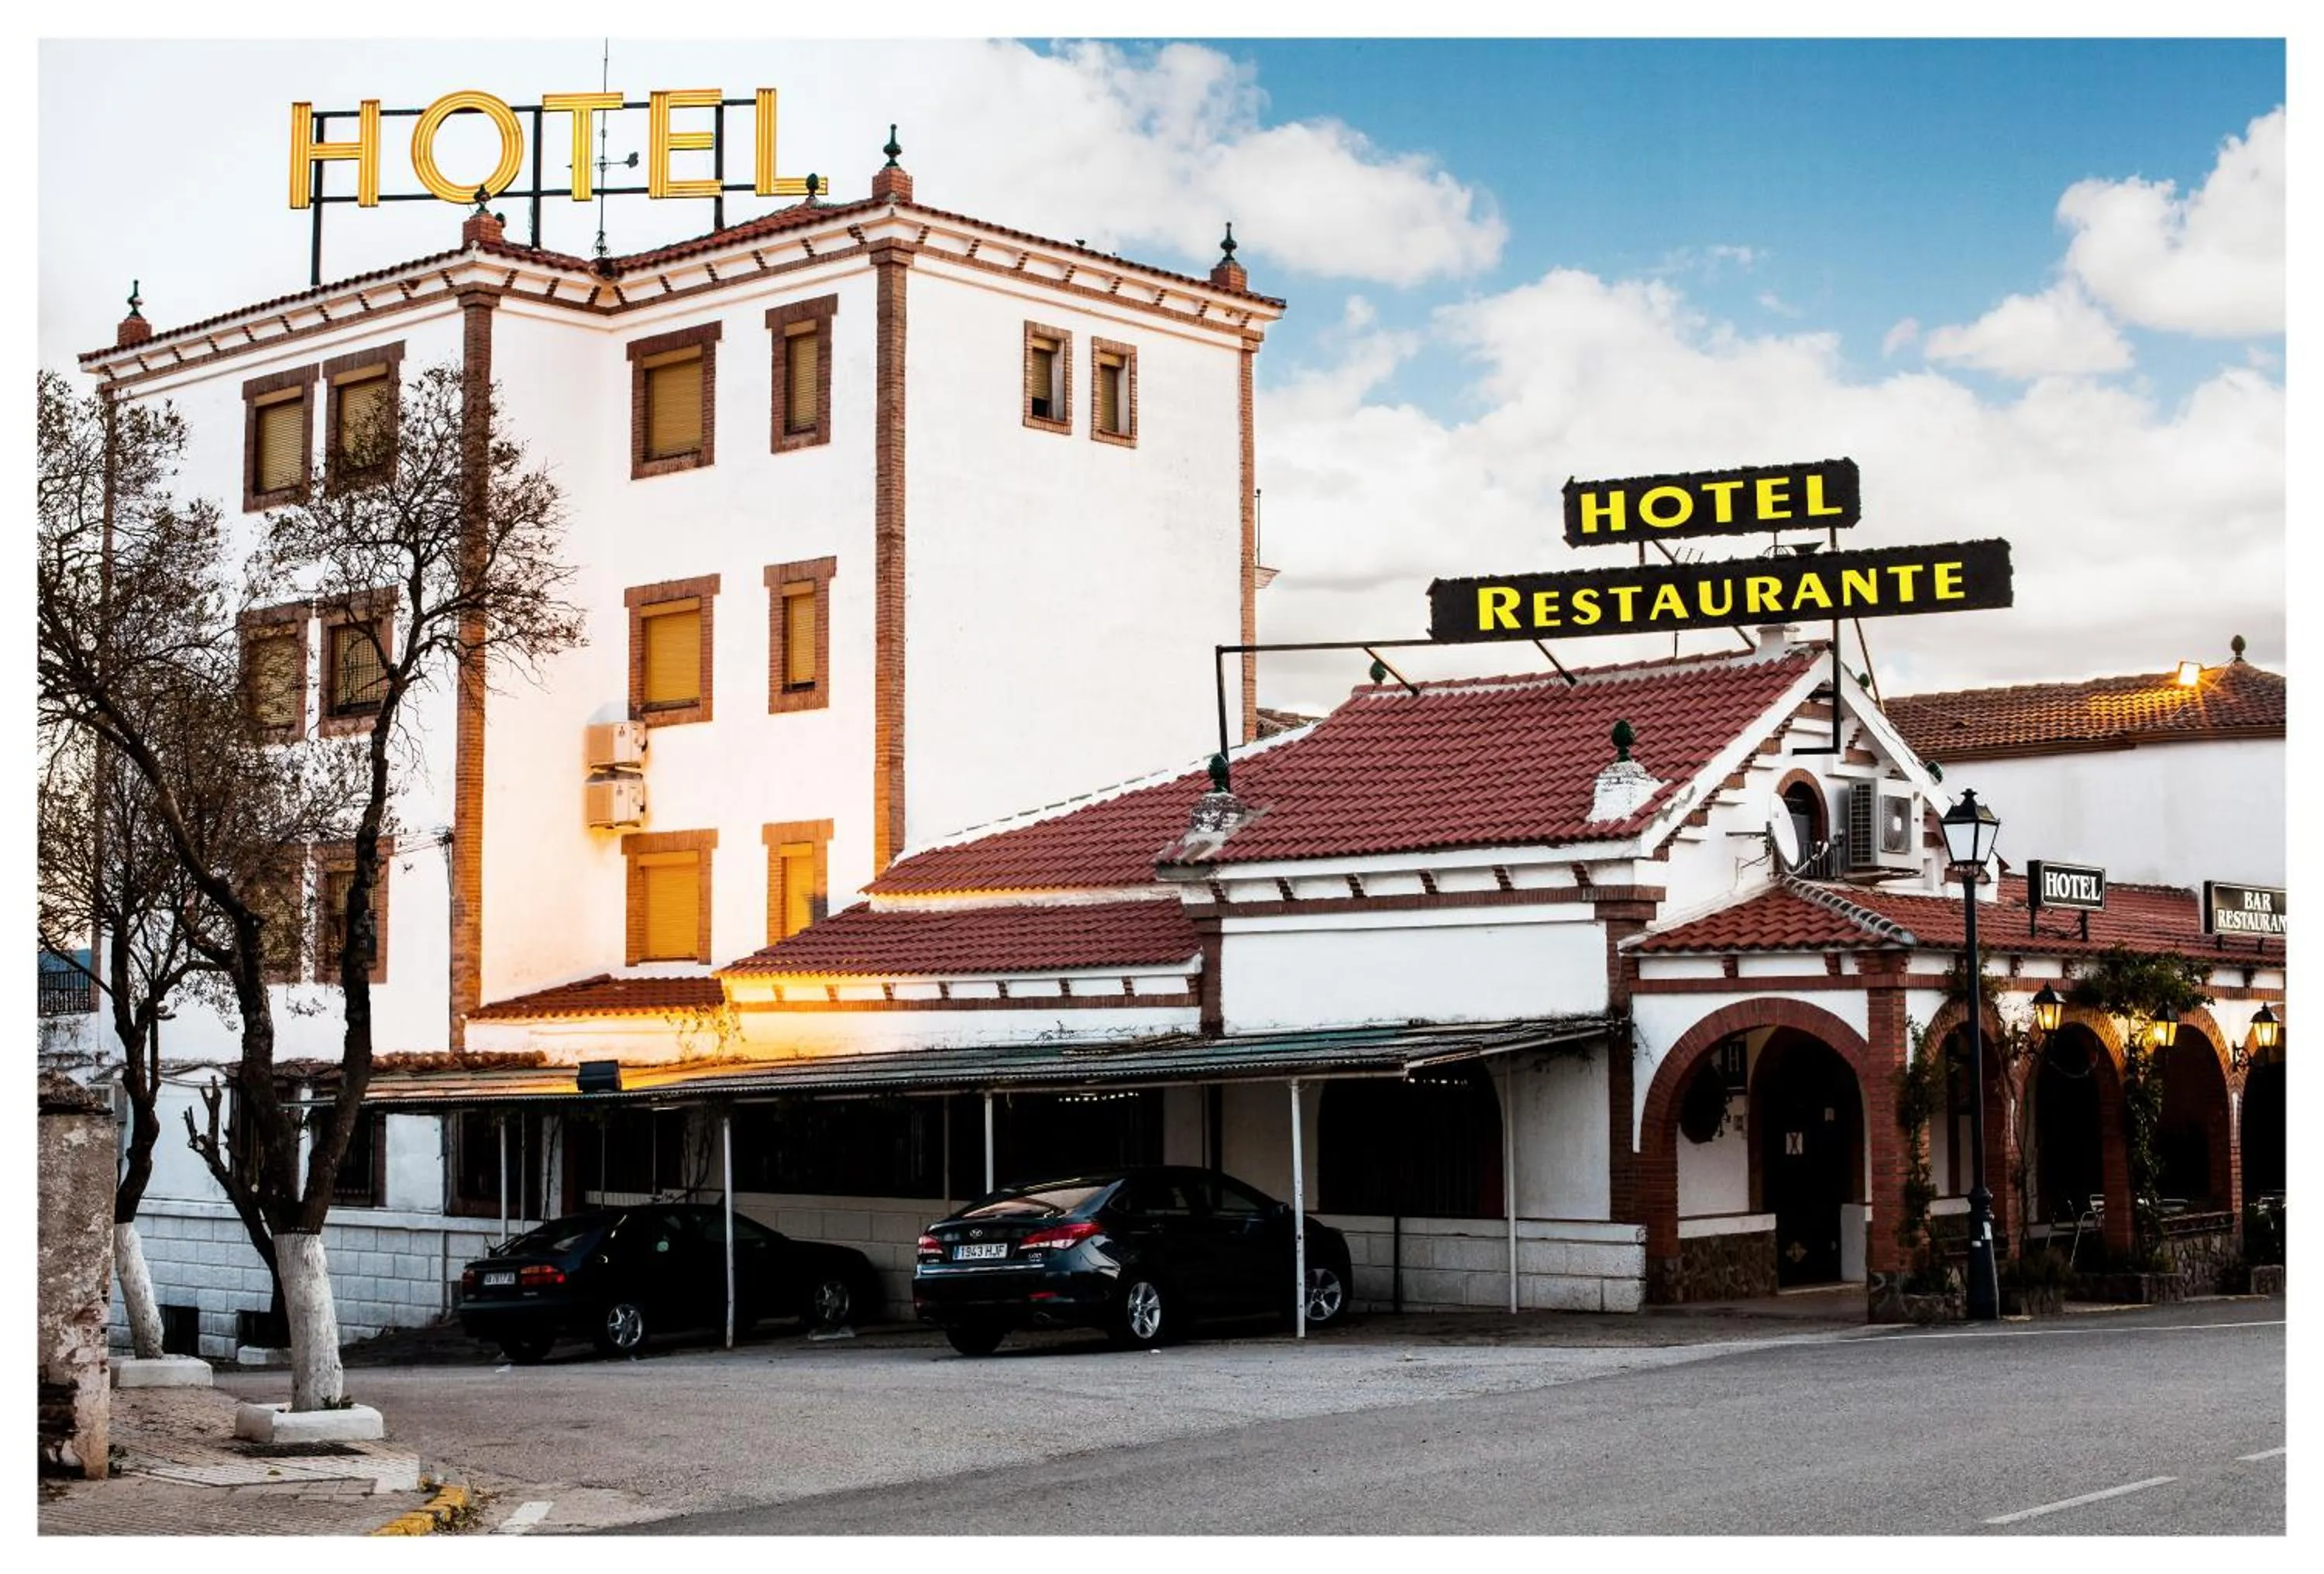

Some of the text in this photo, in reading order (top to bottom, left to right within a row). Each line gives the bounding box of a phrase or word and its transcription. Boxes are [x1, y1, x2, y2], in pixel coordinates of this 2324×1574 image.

[290, 88, 828, 209] HOTEL
[1580, 475, 1842, 534] HOTEL
[1477, 562, 1965, 631] RESTAURANTE
[2045, 871, 2101, 901] HOTEL
[2243, 891, 2272, 911] BAR
